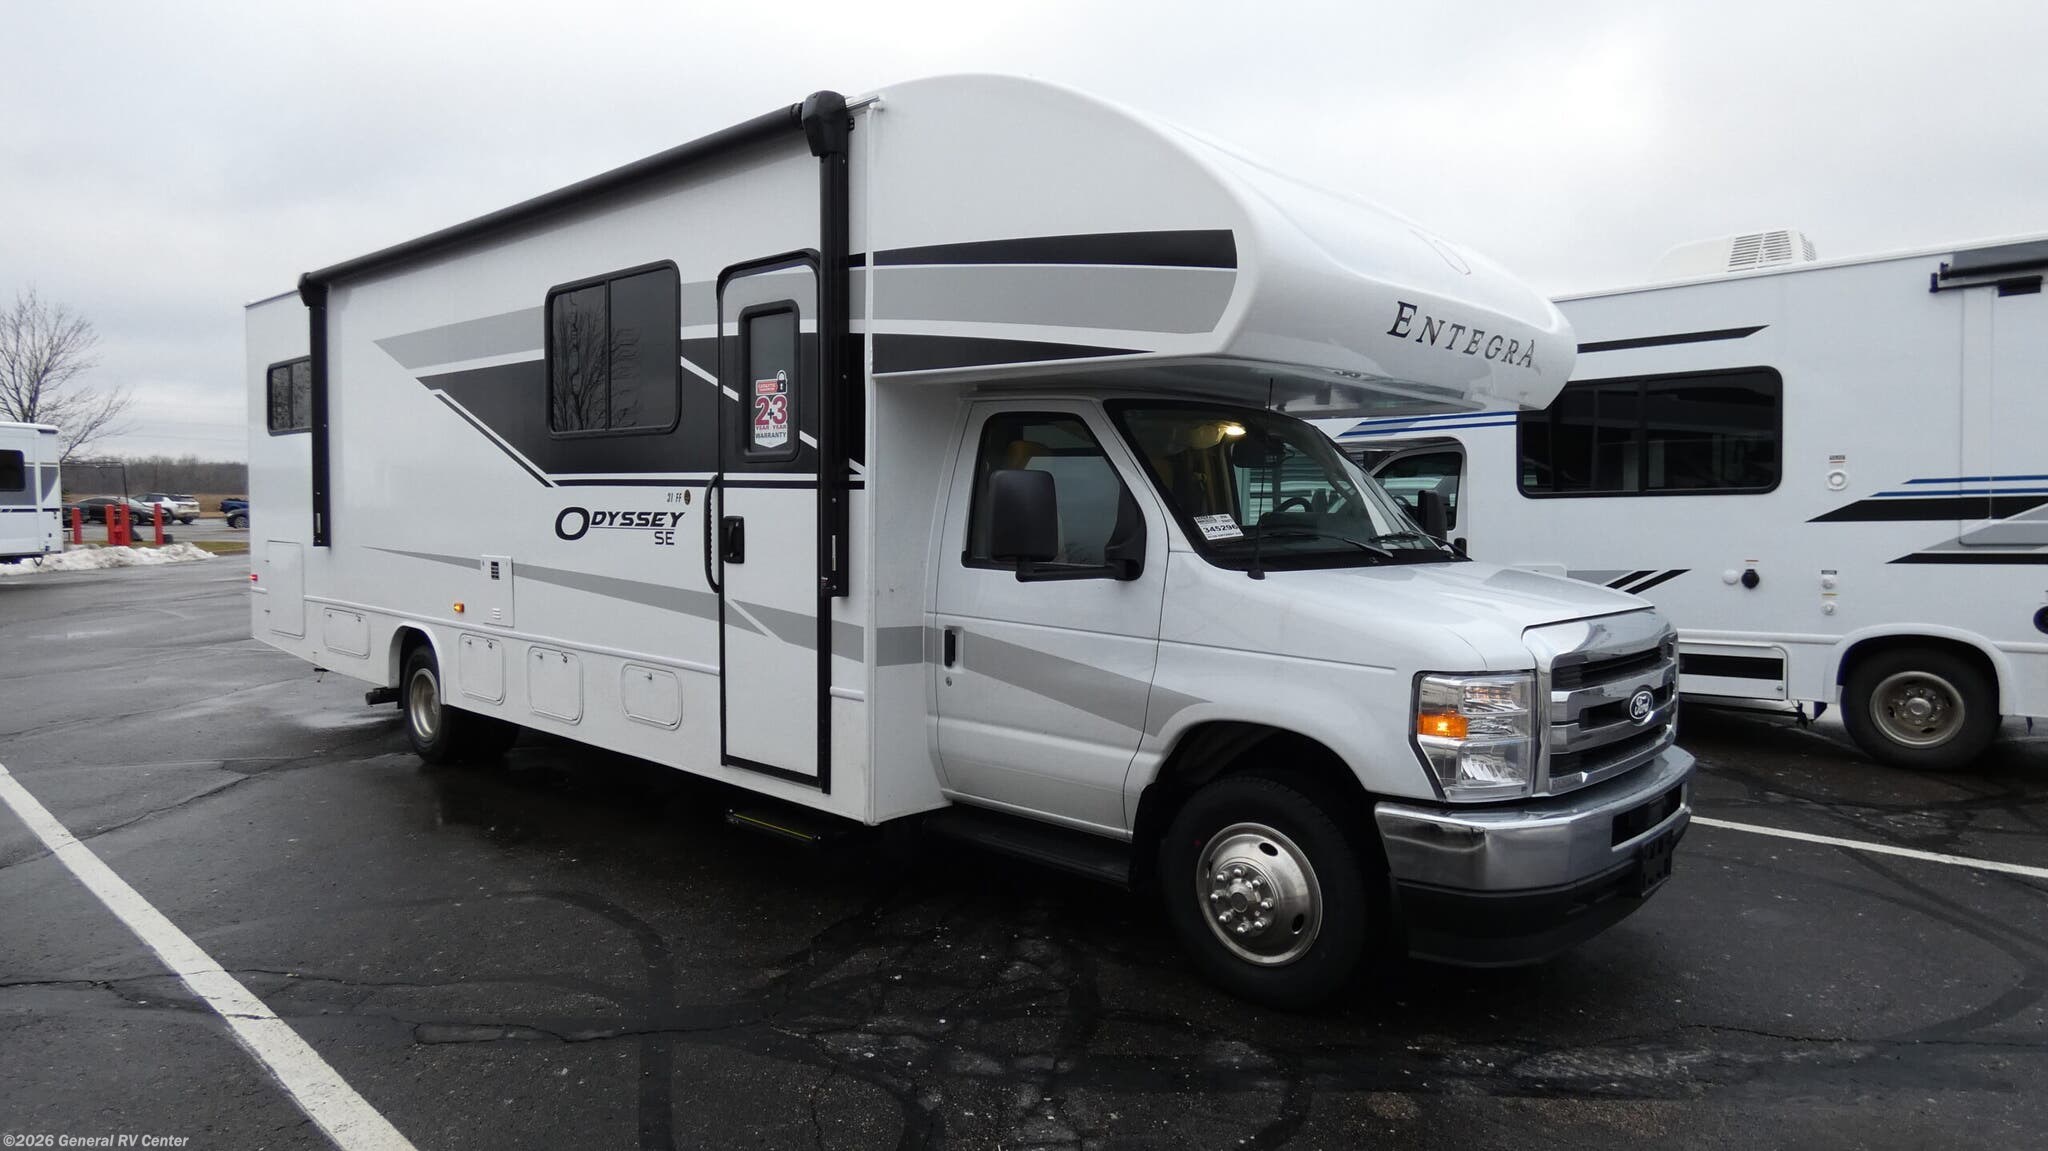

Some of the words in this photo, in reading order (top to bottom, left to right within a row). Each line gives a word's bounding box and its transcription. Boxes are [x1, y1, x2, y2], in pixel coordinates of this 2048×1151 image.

[1386, 301, 1535, 368] ENTEGRA
[555, 507, 685, 540] ODYSSEY
[1203, 524, 1238, 533] 345296
[654, 531, 675, 545] SE
